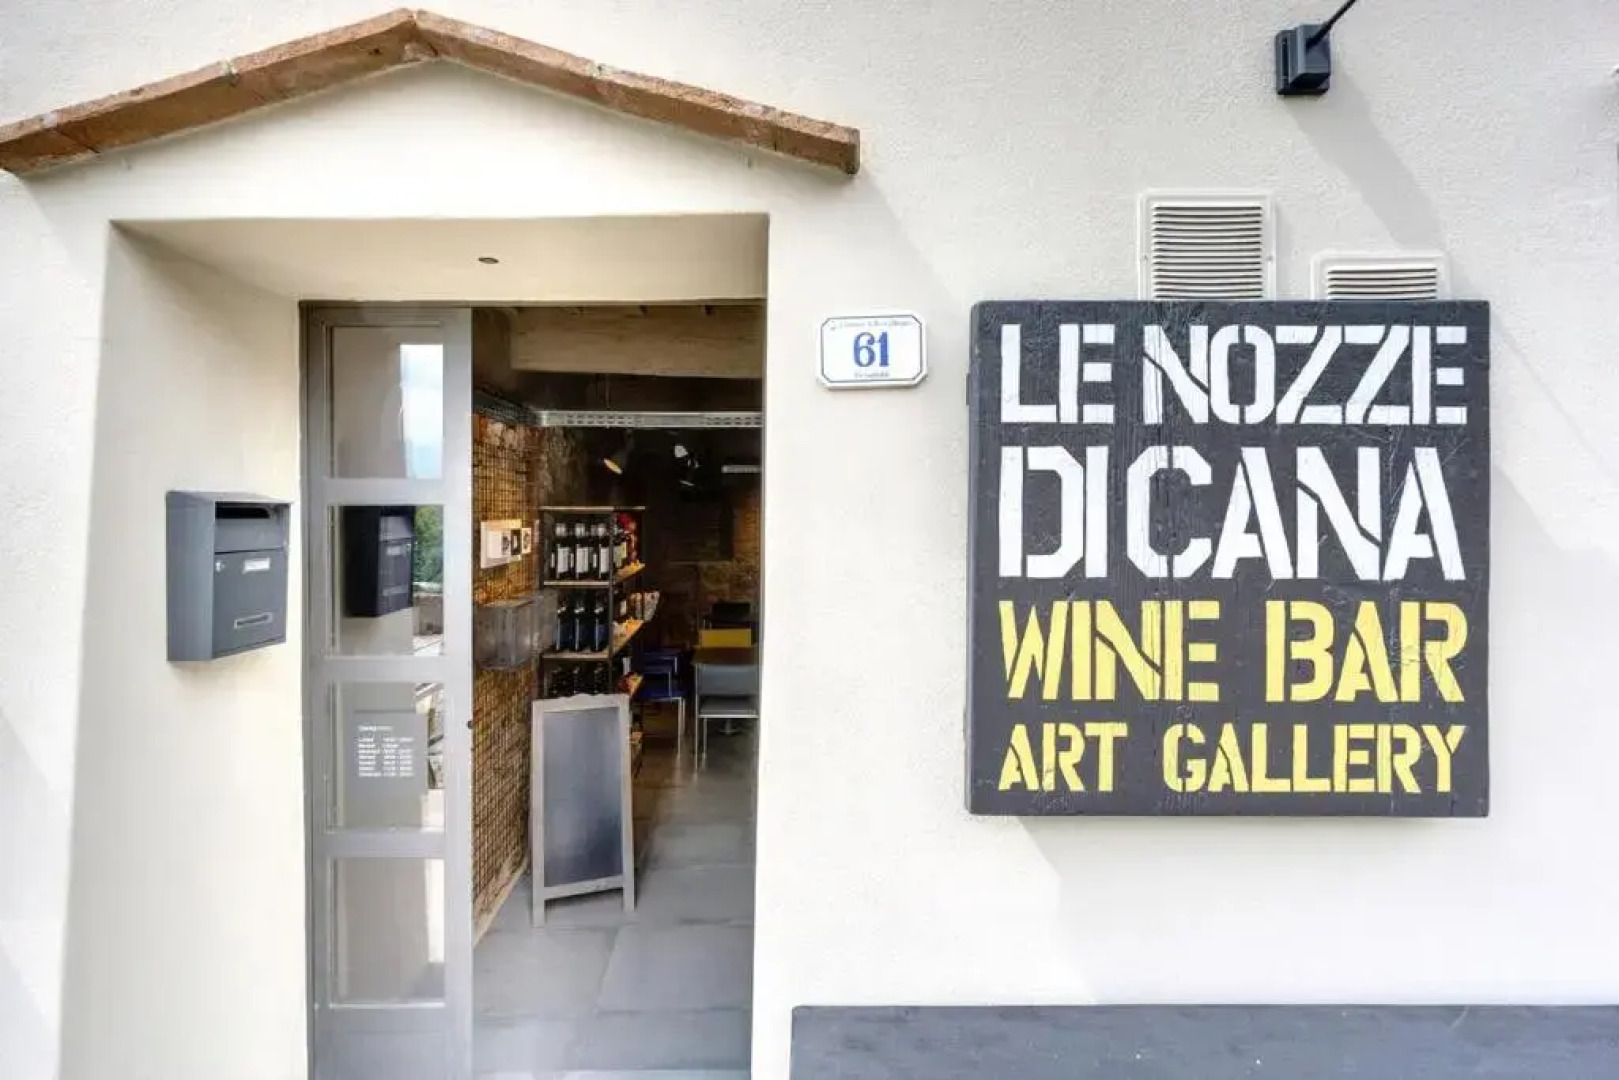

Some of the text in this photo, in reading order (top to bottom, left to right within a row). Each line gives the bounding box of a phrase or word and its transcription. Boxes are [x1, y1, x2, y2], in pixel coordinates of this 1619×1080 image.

[853, 331, 889, 367] 61
[1000, 324, 1467, 425] LE NOZZE
[999, 445, 1466, 581] DI CANA
[999, 600, 1468, 703] WINE BAR
[999, 722, 1466, 794] ART GALLERY
